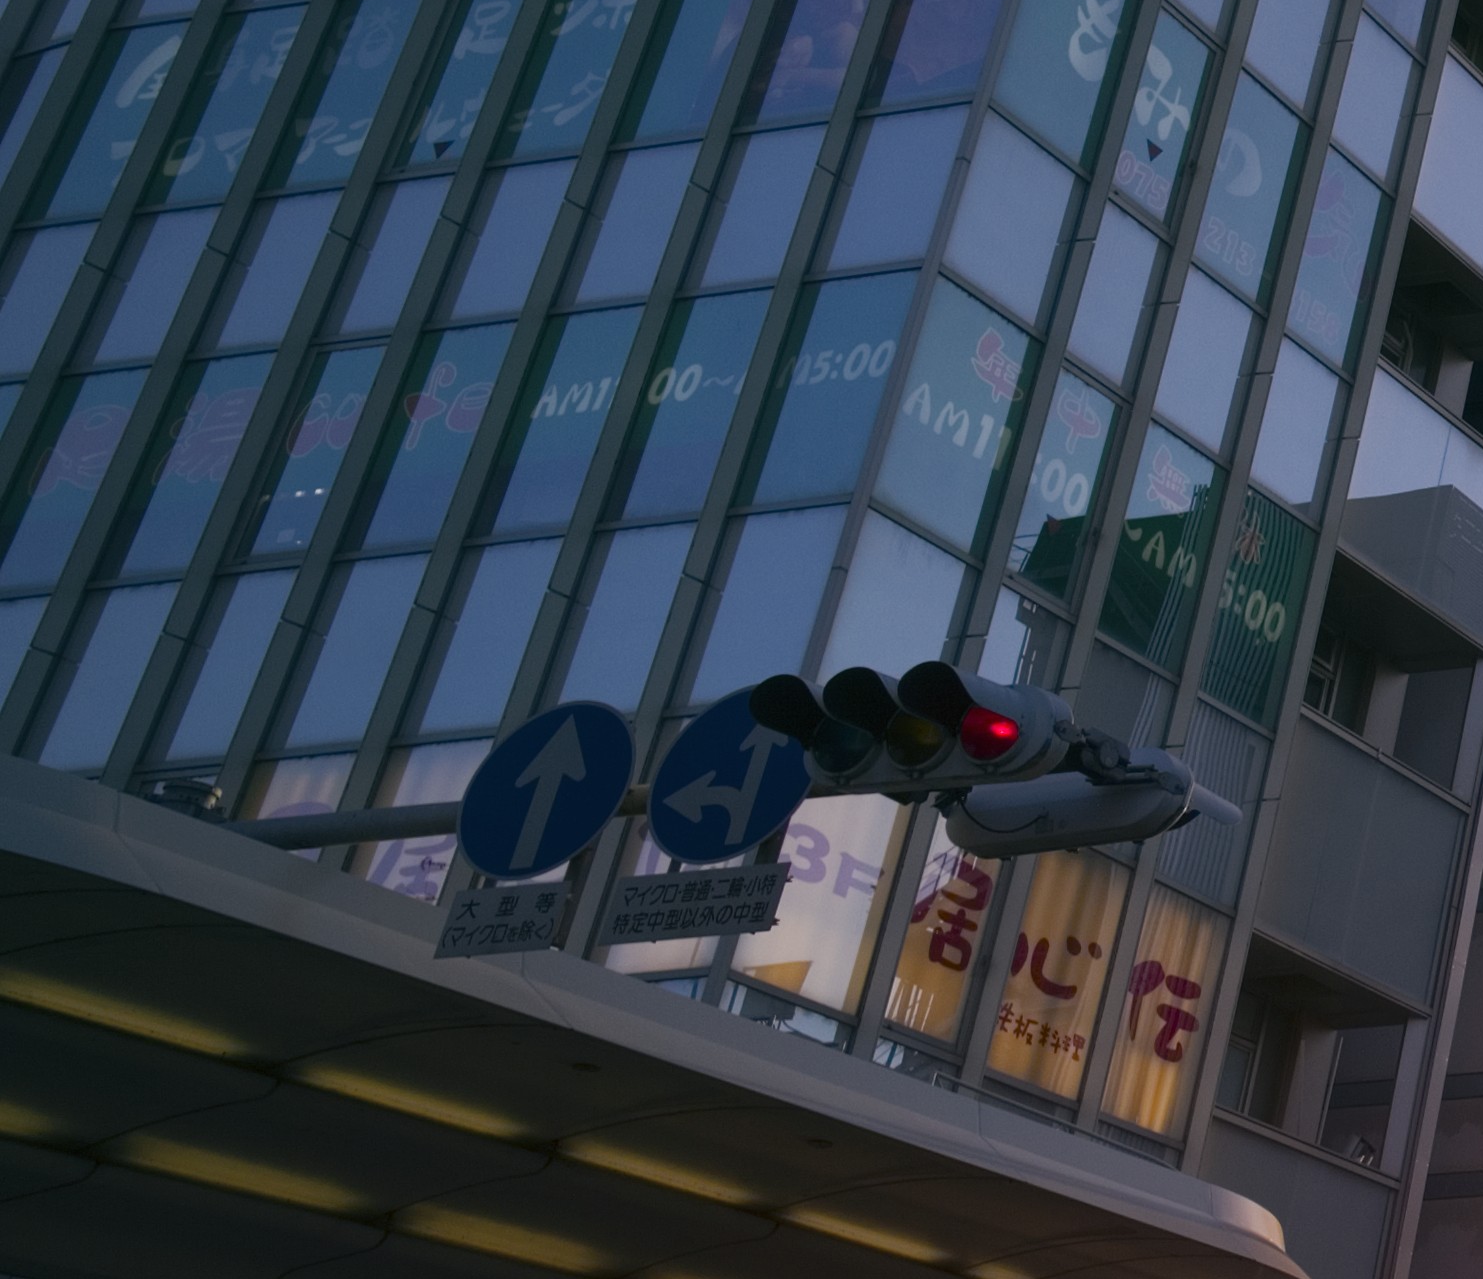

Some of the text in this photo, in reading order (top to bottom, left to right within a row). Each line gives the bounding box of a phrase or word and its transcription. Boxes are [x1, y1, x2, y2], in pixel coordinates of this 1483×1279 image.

[612, 900, 769, 936] 特定中型以外の中型
